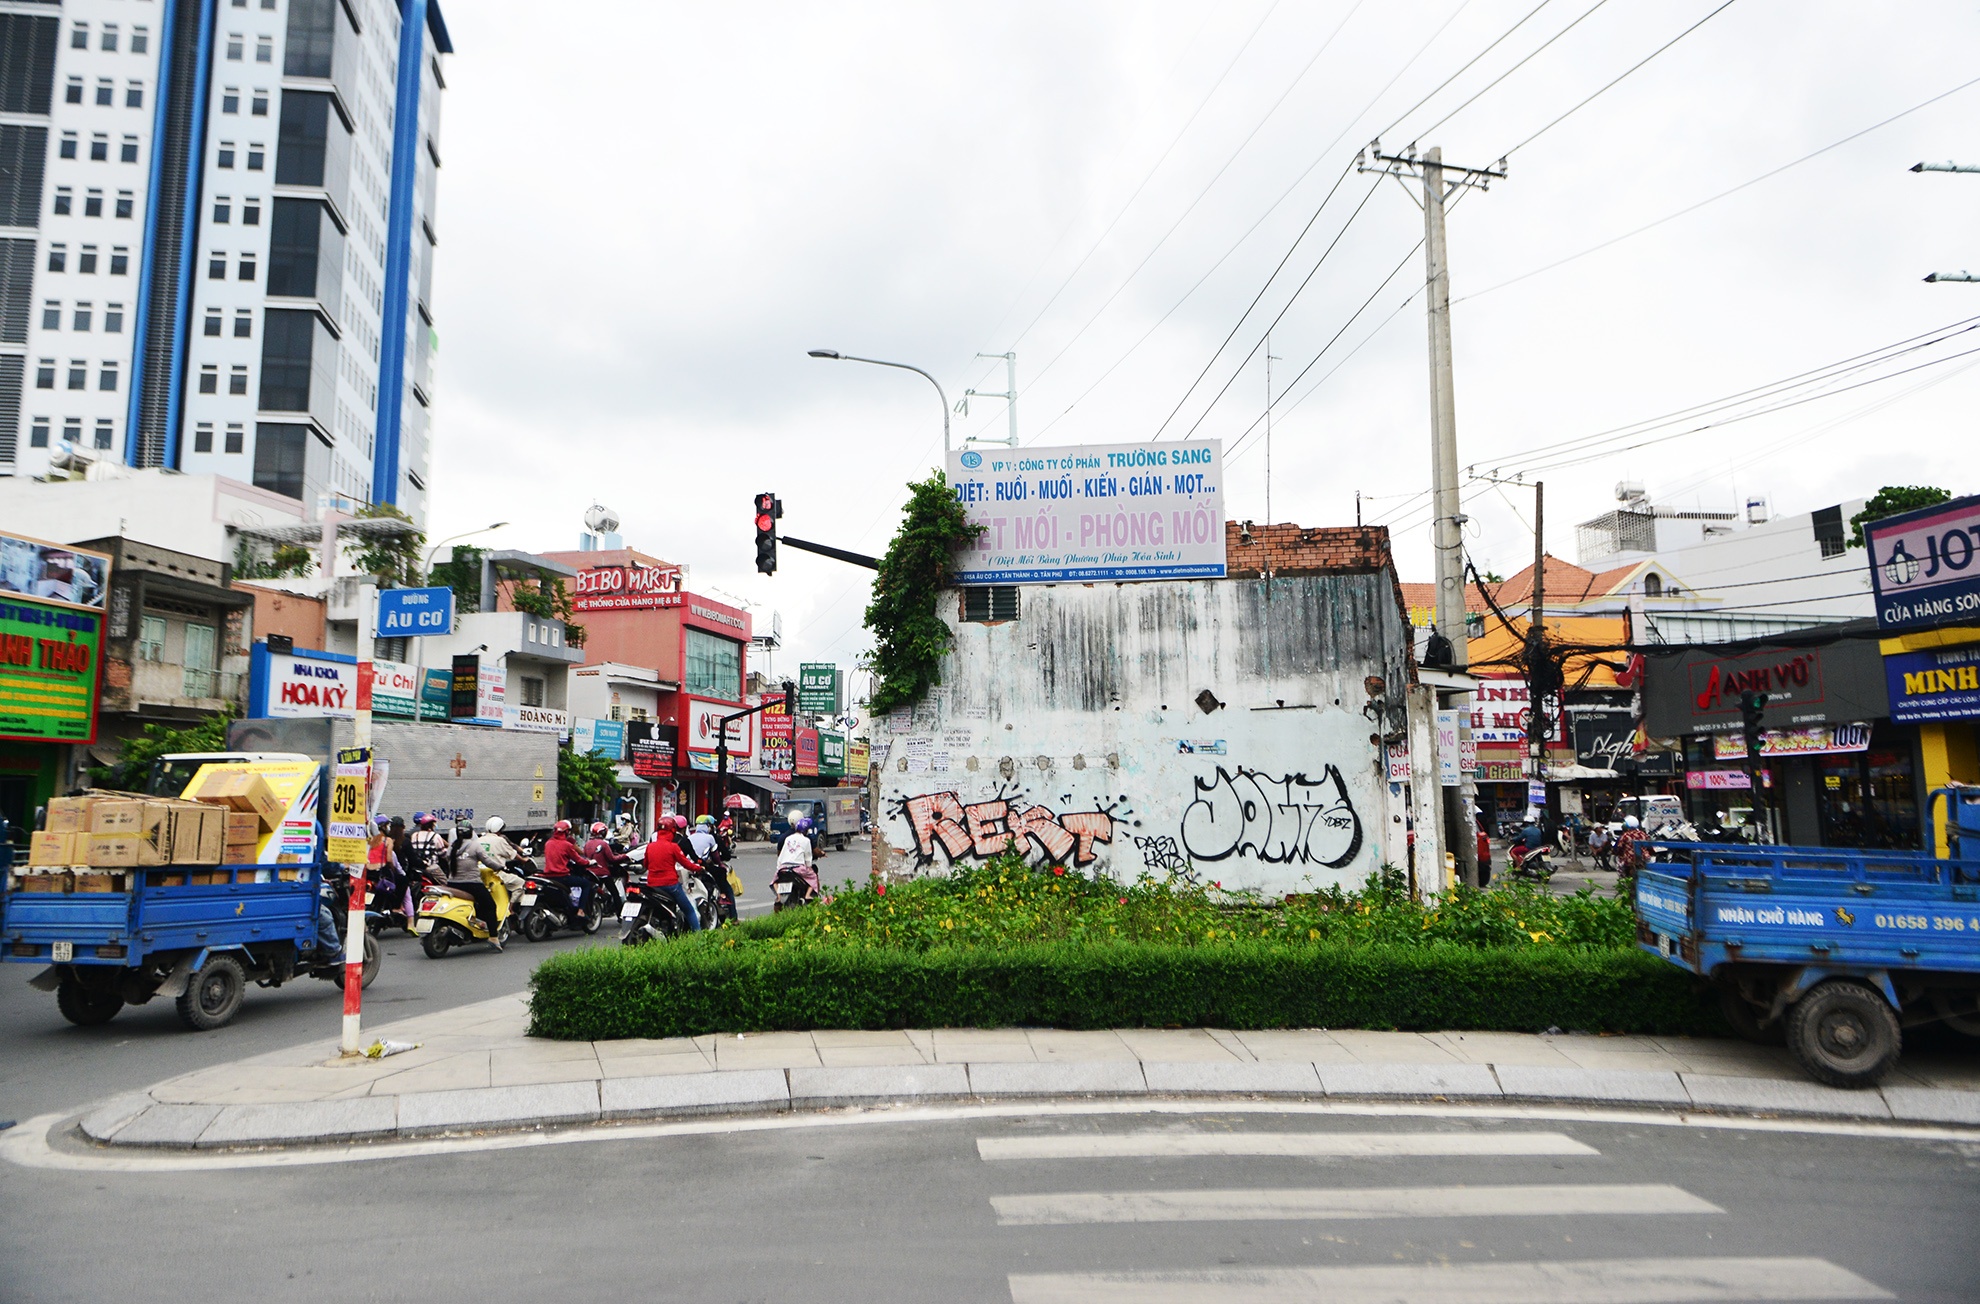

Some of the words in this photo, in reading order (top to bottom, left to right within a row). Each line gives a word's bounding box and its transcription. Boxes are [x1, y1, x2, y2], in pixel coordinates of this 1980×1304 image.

[992, 462, 1003, 472] VP
[1020, 458, 1044, 471] CÔNG
[1047, 459, 1058, 470] TY
[1060, 453, 1073, 470] CỔ
[1107, 449, 1167, 468] TRƯỜNG
[1171, 448, 1212, 465] SANG
[954, 478, 989, 508] DIỆT:
[995, 474, 1027, 501] RUỒI
[1038, 473, 1072, 500] MUỖI
[1084, 471, 1117, 498] KIẾN
[1129, 471, 1162, 497] GIÁN
[1174, 473, 1216, 500] MỌT...
[1014, 505, 1058, 550] MỐI
[1080, 503, 1164, 548] PHÒNG
[1172, 498, 1217, 544] MỐI
[576, 570, 622, 593] BIBO
[629, 567, 678, 590] MART
[402, 592, 429, 605] ĐƯỜNG
[578, 600, 588, 611] HỆ
[590, 596, 614, 609] THỐNG
[616, 597, 630, 608] CỬA
[632, 596, 653, 607] HÀNG
[655, 597, 664, 607] MẸ
[672, 594, 682, 604] BÉ
[386, 610, 413, 628] ÂU
[419, 609, 444, 627] CƠ
[1884, 602, 1911, 623] CỬA
[1913, 597, 1953, 618] HÀNG
[38, 629, 91, 674] THẢO
[294, 664, 312, 677] NHA
[314, 667, 339, 680] KHOA
[802, 673, 816, 685] ÂU
[818, 673, 832, 685] CƠ
[1723, 668, 1772, 696] ANH
[1903, 666, 1980, 696] MINH
[281, 682, 319, 706] HOA
[322, 684, 348, 708] KỲ
[520, 709, 553, 724] HOÀNG
[764, 737, 788, 748] 10%
[1482, 732, 1497, 740] ĐA
[1489, 763, 1523, 779] Giảm
[333, 784, 356, 814] 319
[1717, 908, 1755, 925] NHẬN
[1756, 906, 1785, 925] CHỞ
[1787, 908, 1824, 926] HÀNG
[1875, 913, 1928, 930] 01658
[1932, 916, 1965, 932] 396
[1968, 917, 1980, 932] 4
